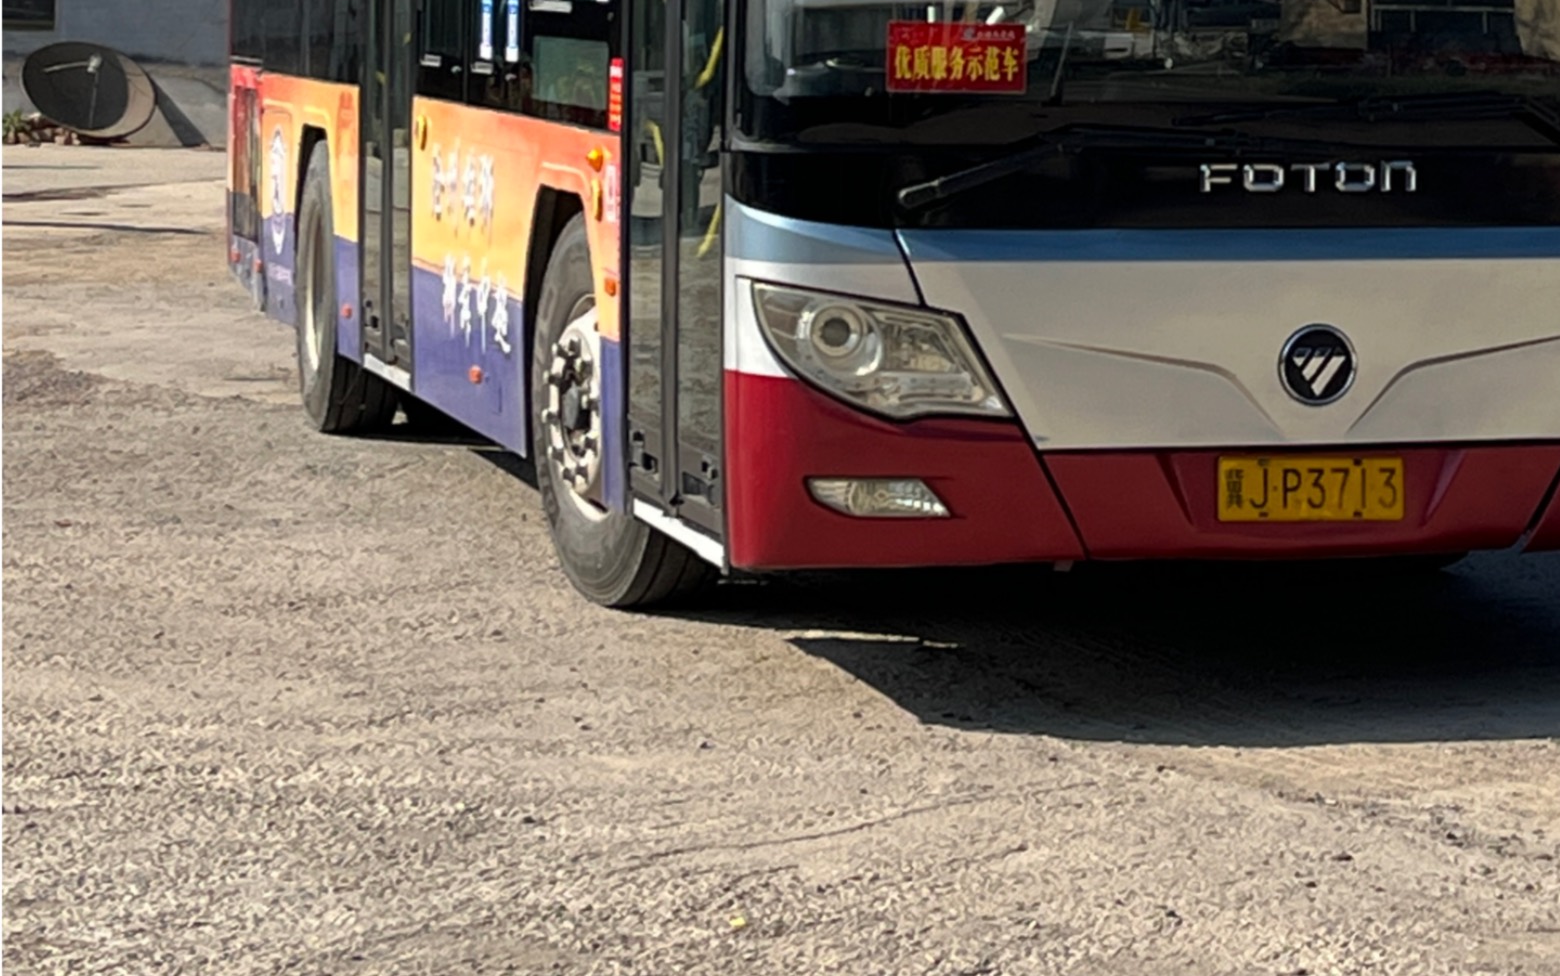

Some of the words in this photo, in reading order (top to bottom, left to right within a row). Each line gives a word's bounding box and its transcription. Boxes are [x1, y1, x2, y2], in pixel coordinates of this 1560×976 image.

[894, 43, 1019, 82] 优质服务示范车
[1200, 160, 1417, 192] FOTON
